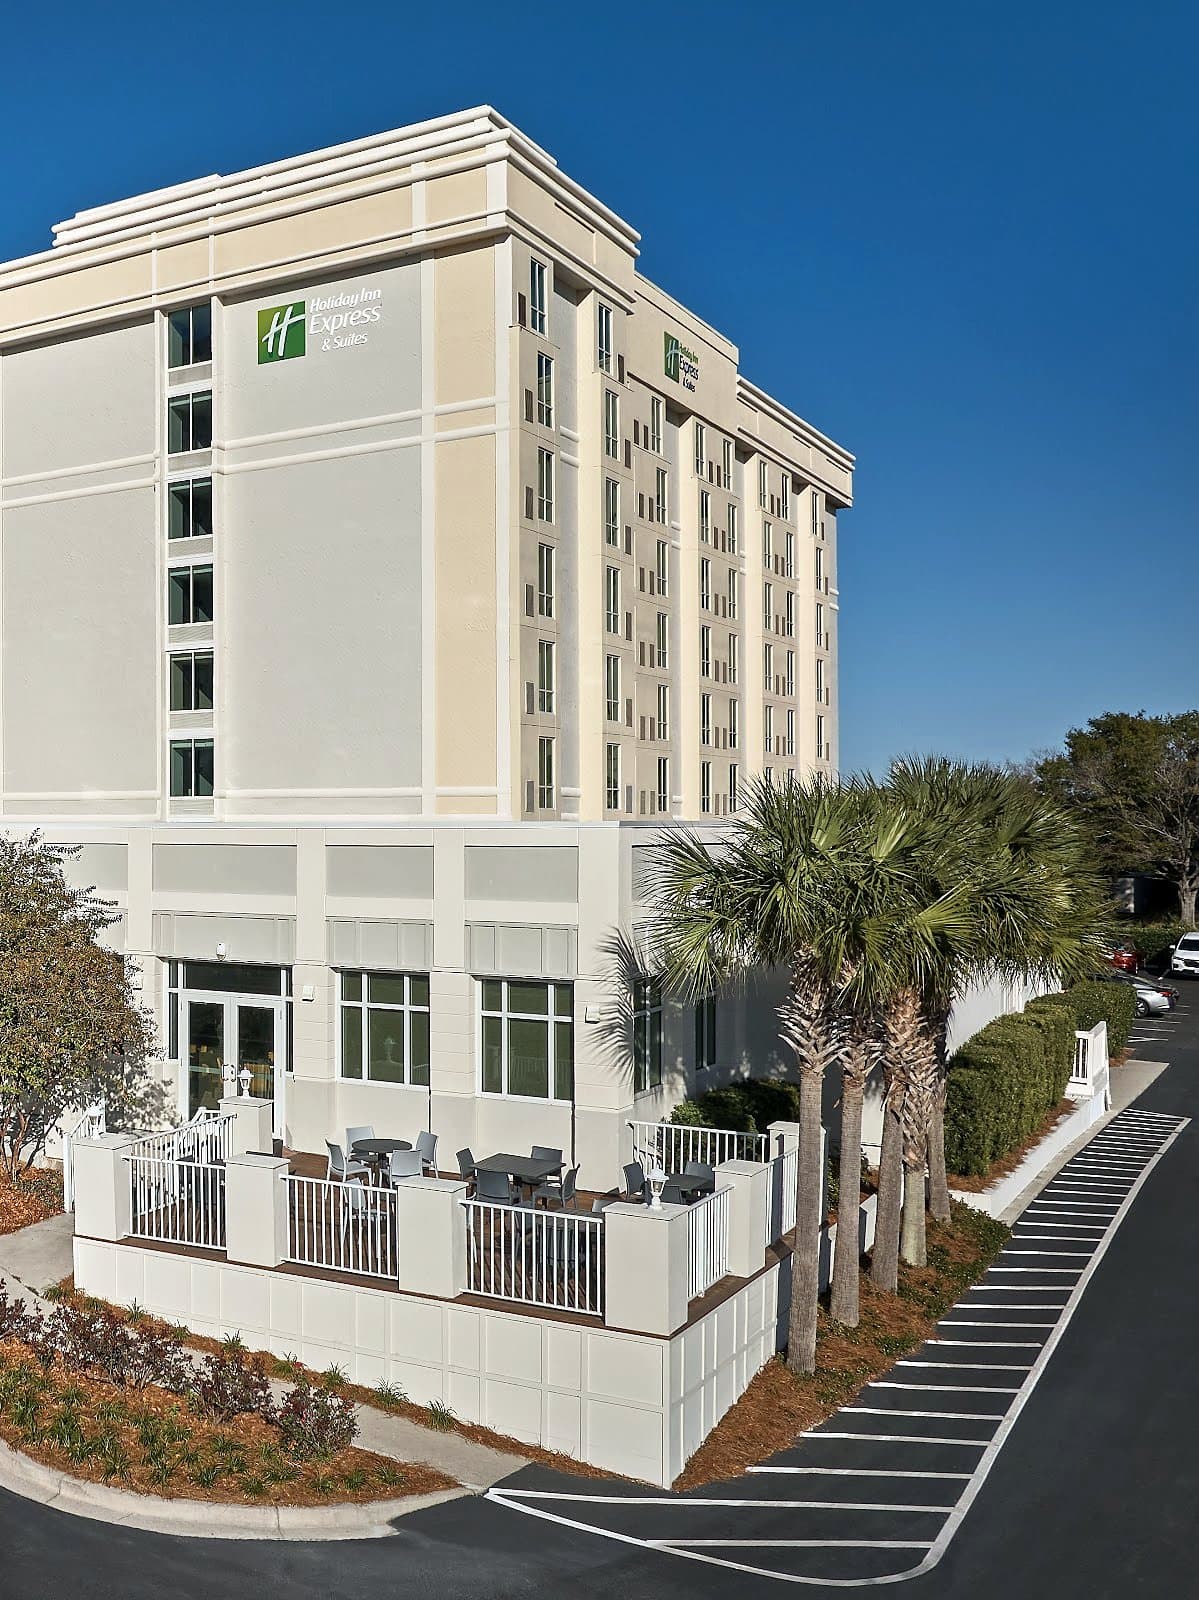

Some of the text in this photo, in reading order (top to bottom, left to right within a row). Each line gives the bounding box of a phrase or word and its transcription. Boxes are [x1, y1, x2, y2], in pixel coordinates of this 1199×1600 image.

[310, 287, 382, 313] Holiday Inn
[309, 305, 382, 335] Express
[321, 332, 368, 352] & Suites
